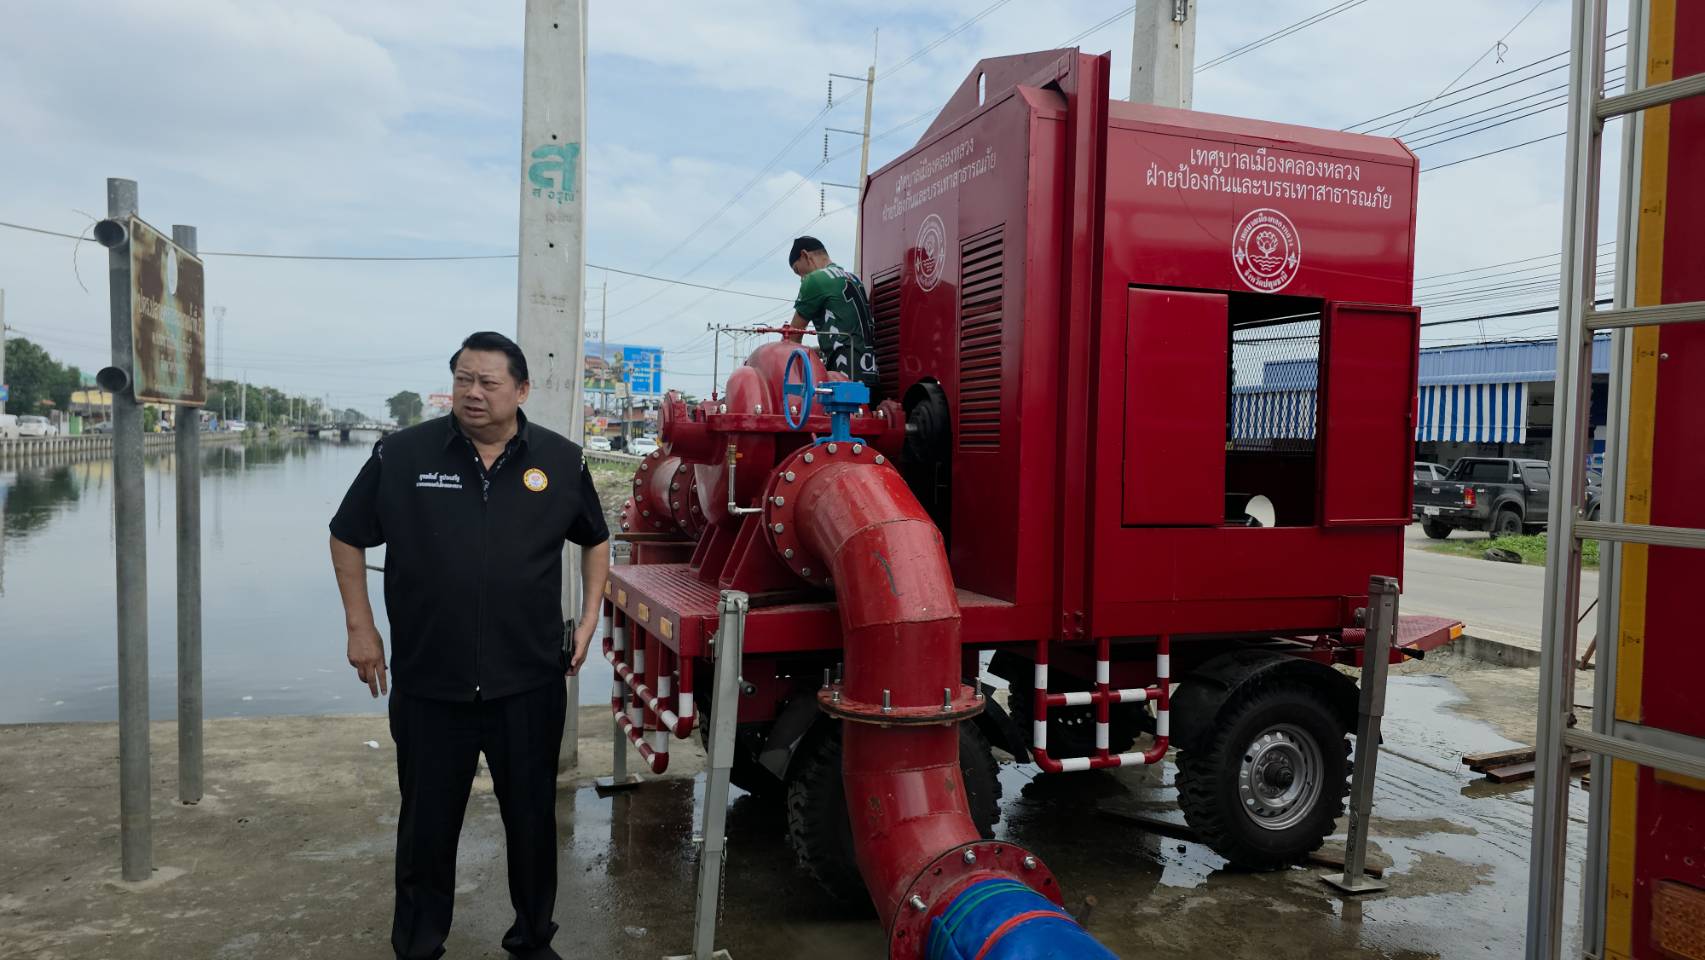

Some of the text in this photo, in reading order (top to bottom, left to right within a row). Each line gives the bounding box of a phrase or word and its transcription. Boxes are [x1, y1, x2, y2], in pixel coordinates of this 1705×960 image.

[1190, 147, 1360, 181] เทศบาลเมืองคลองหลวง
[1146, 162, 1392, 209] ฝ่ายป้องกันและบรรเทาสาธารณภัย
